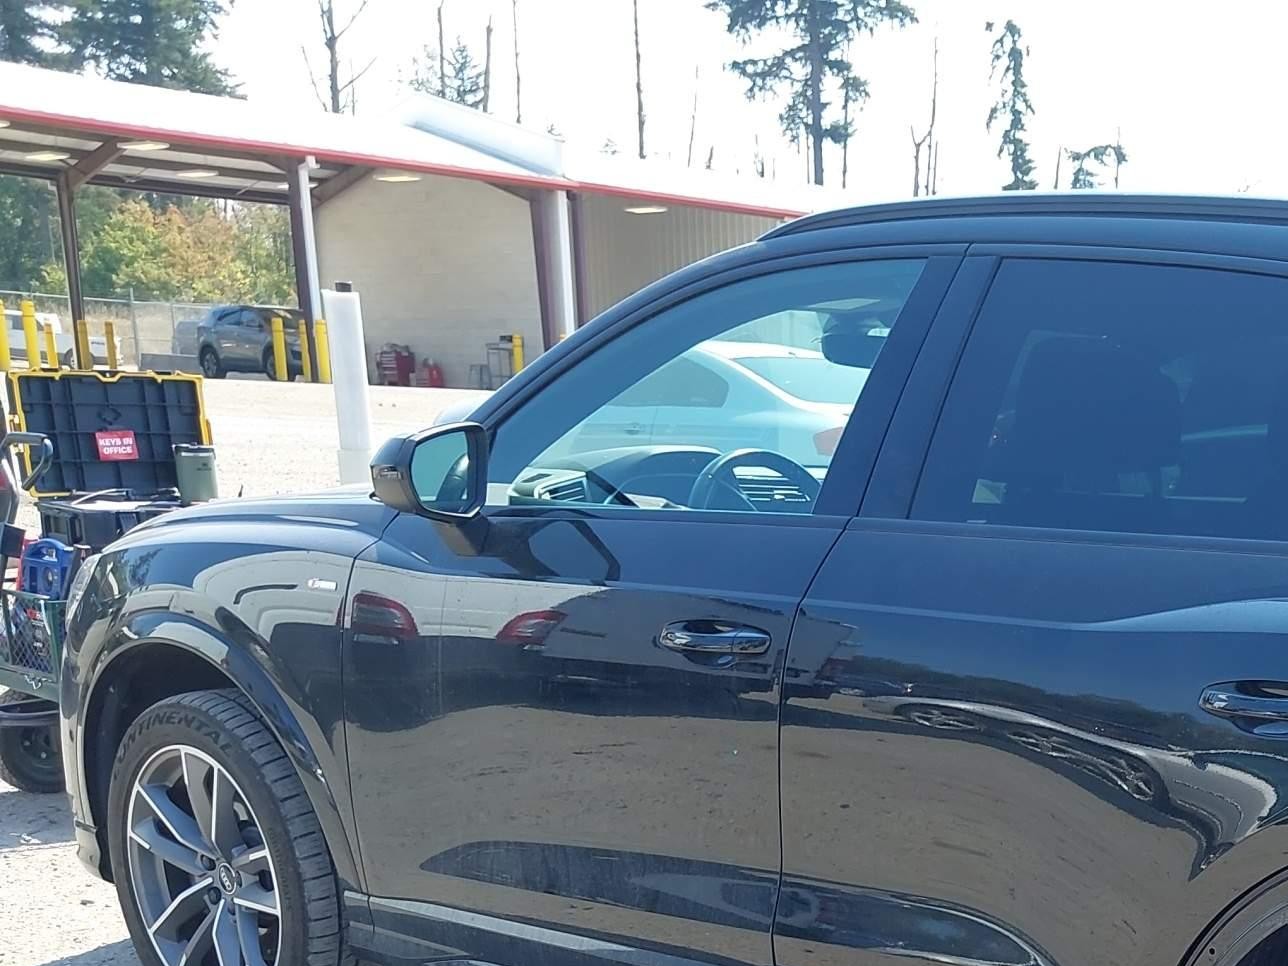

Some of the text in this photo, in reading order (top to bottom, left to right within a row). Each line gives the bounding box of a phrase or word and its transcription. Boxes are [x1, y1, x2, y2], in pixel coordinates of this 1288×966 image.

[99, 437, 133, 447] KEYS IN
[103, 446, 133, 455] OFFICE
